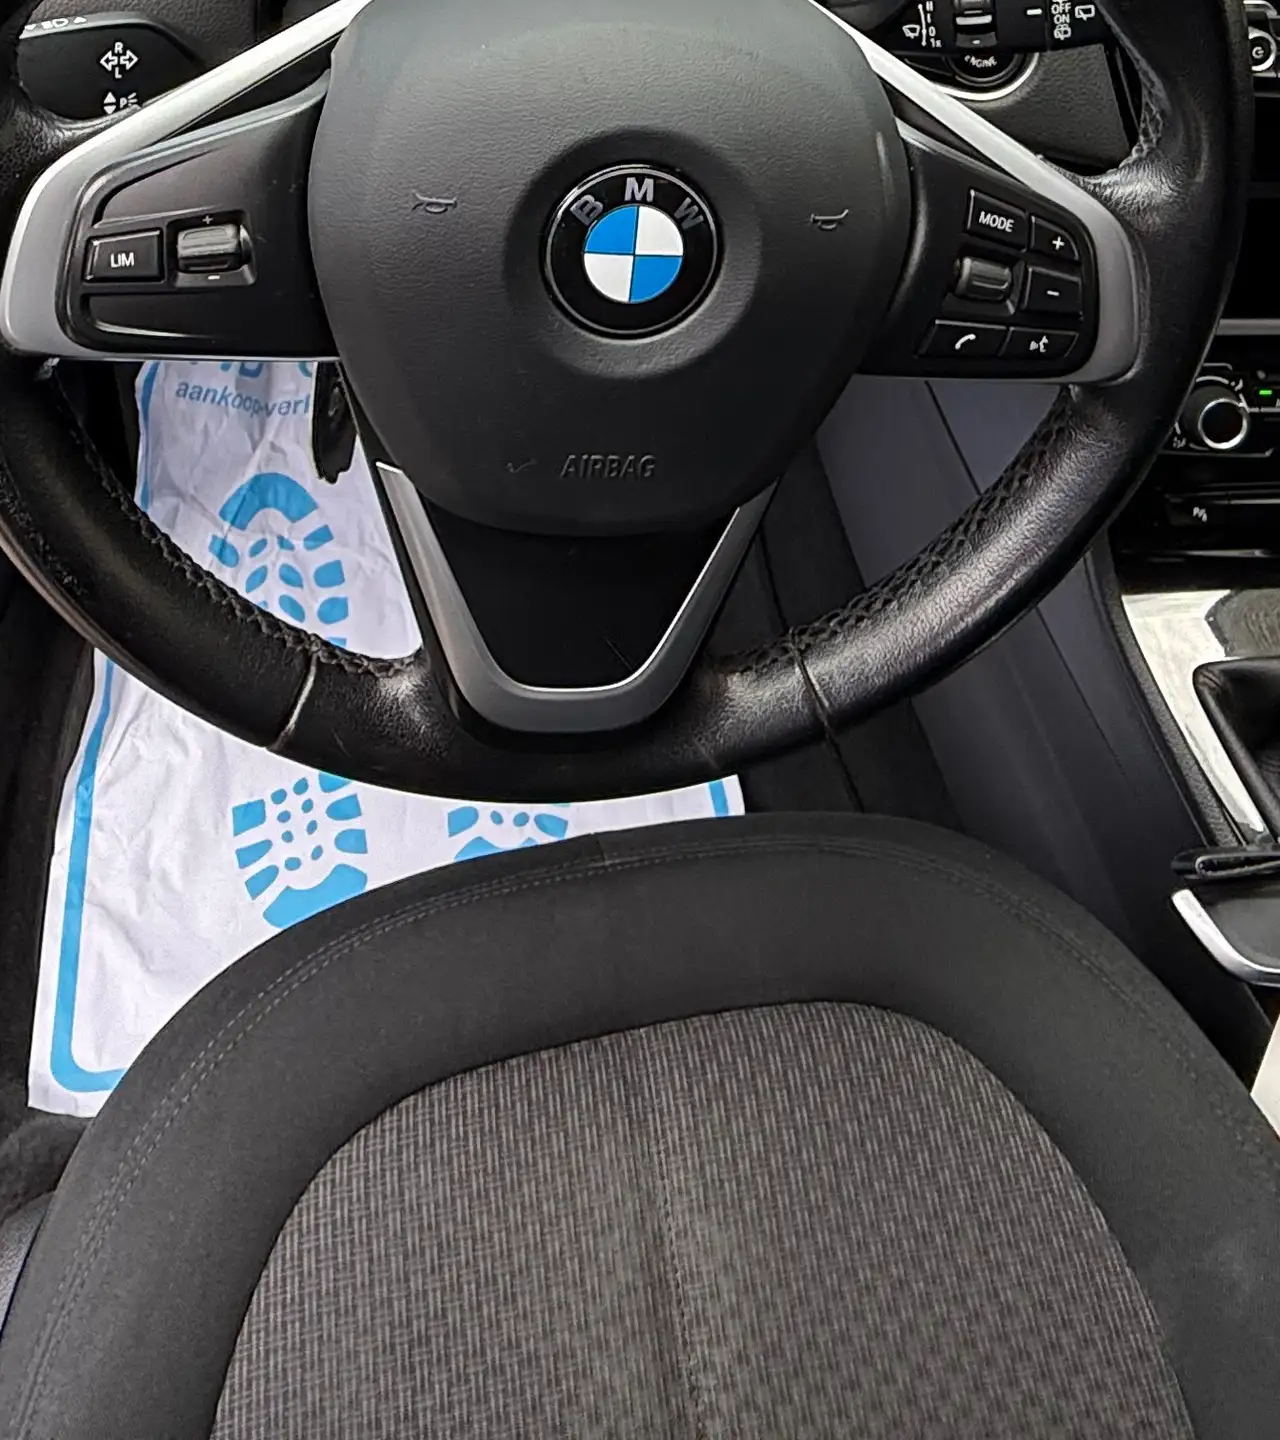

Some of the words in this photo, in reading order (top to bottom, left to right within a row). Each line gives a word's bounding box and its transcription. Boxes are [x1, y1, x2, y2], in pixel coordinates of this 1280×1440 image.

[1051, 3, 1071, 15] OFF
[1054, 14, 1070, 24] ON
[928, 26, 936, 37] 0
[114, 41, 123, 54] R
[929, 37, 942, 49] 1x
[114, 67, 122, 79] L
[568, 176, 706, 232] BMW
[978, 211, 1014, 232] MODE
[110, 252, 135, 268] LIM
[559, 453, 659, 478] AIRBAG
